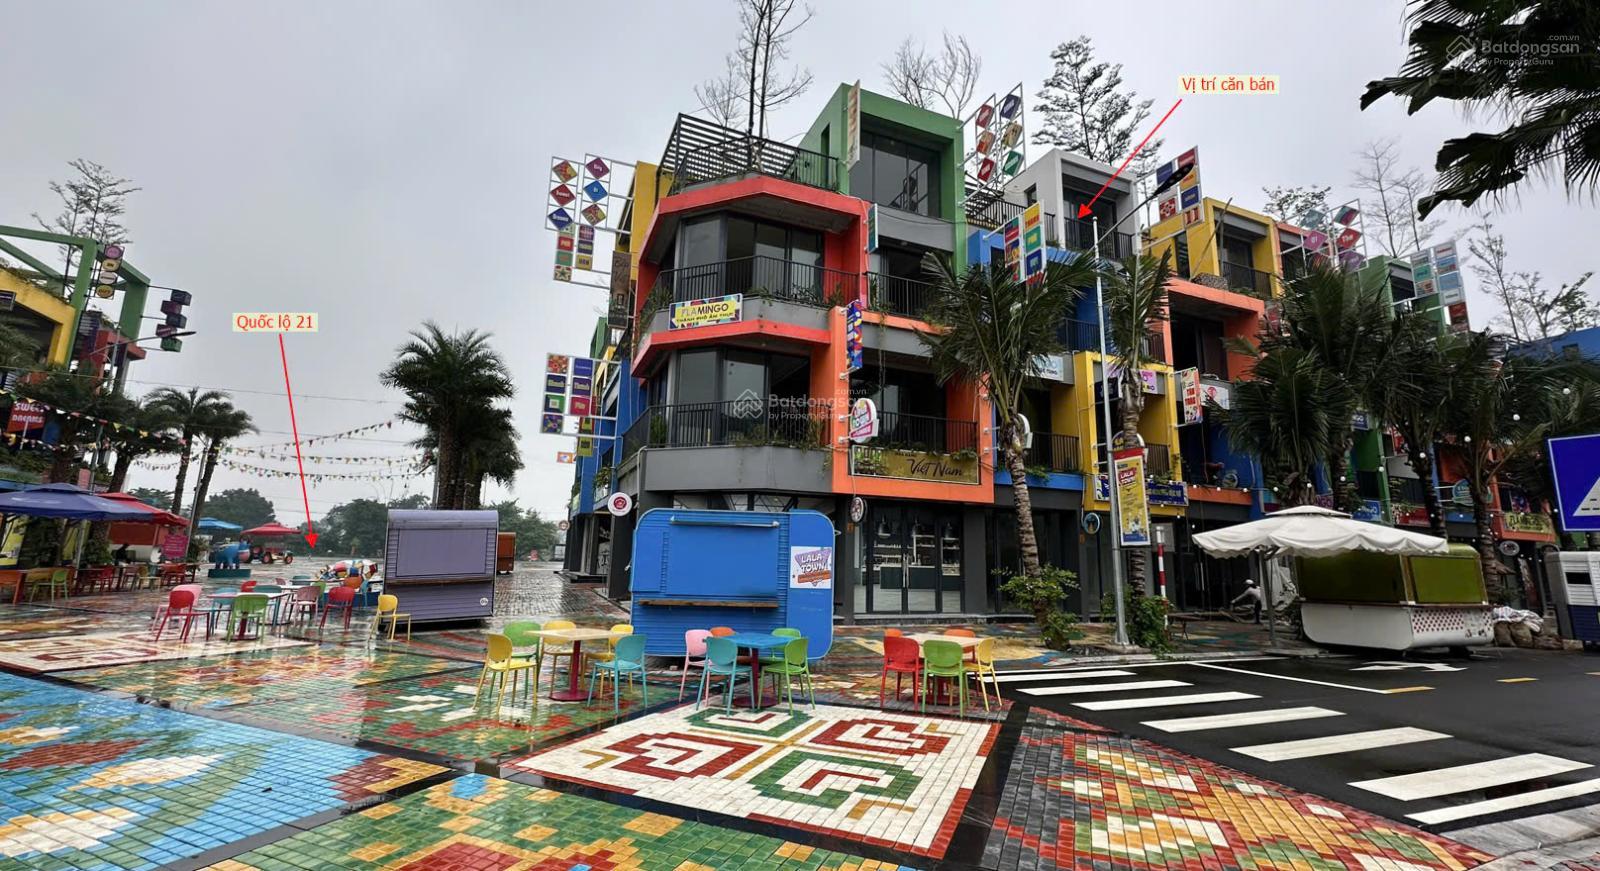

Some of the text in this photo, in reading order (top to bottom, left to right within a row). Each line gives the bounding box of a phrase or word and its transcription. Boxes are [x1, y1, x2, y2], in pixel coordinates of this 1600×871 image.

[682, 303, 728, 317] FLAMINGO
[14, 402, 43, 412] SWE
[801, 553, 822, 563] LALA
[801, 562, 826, 573] TOWN
